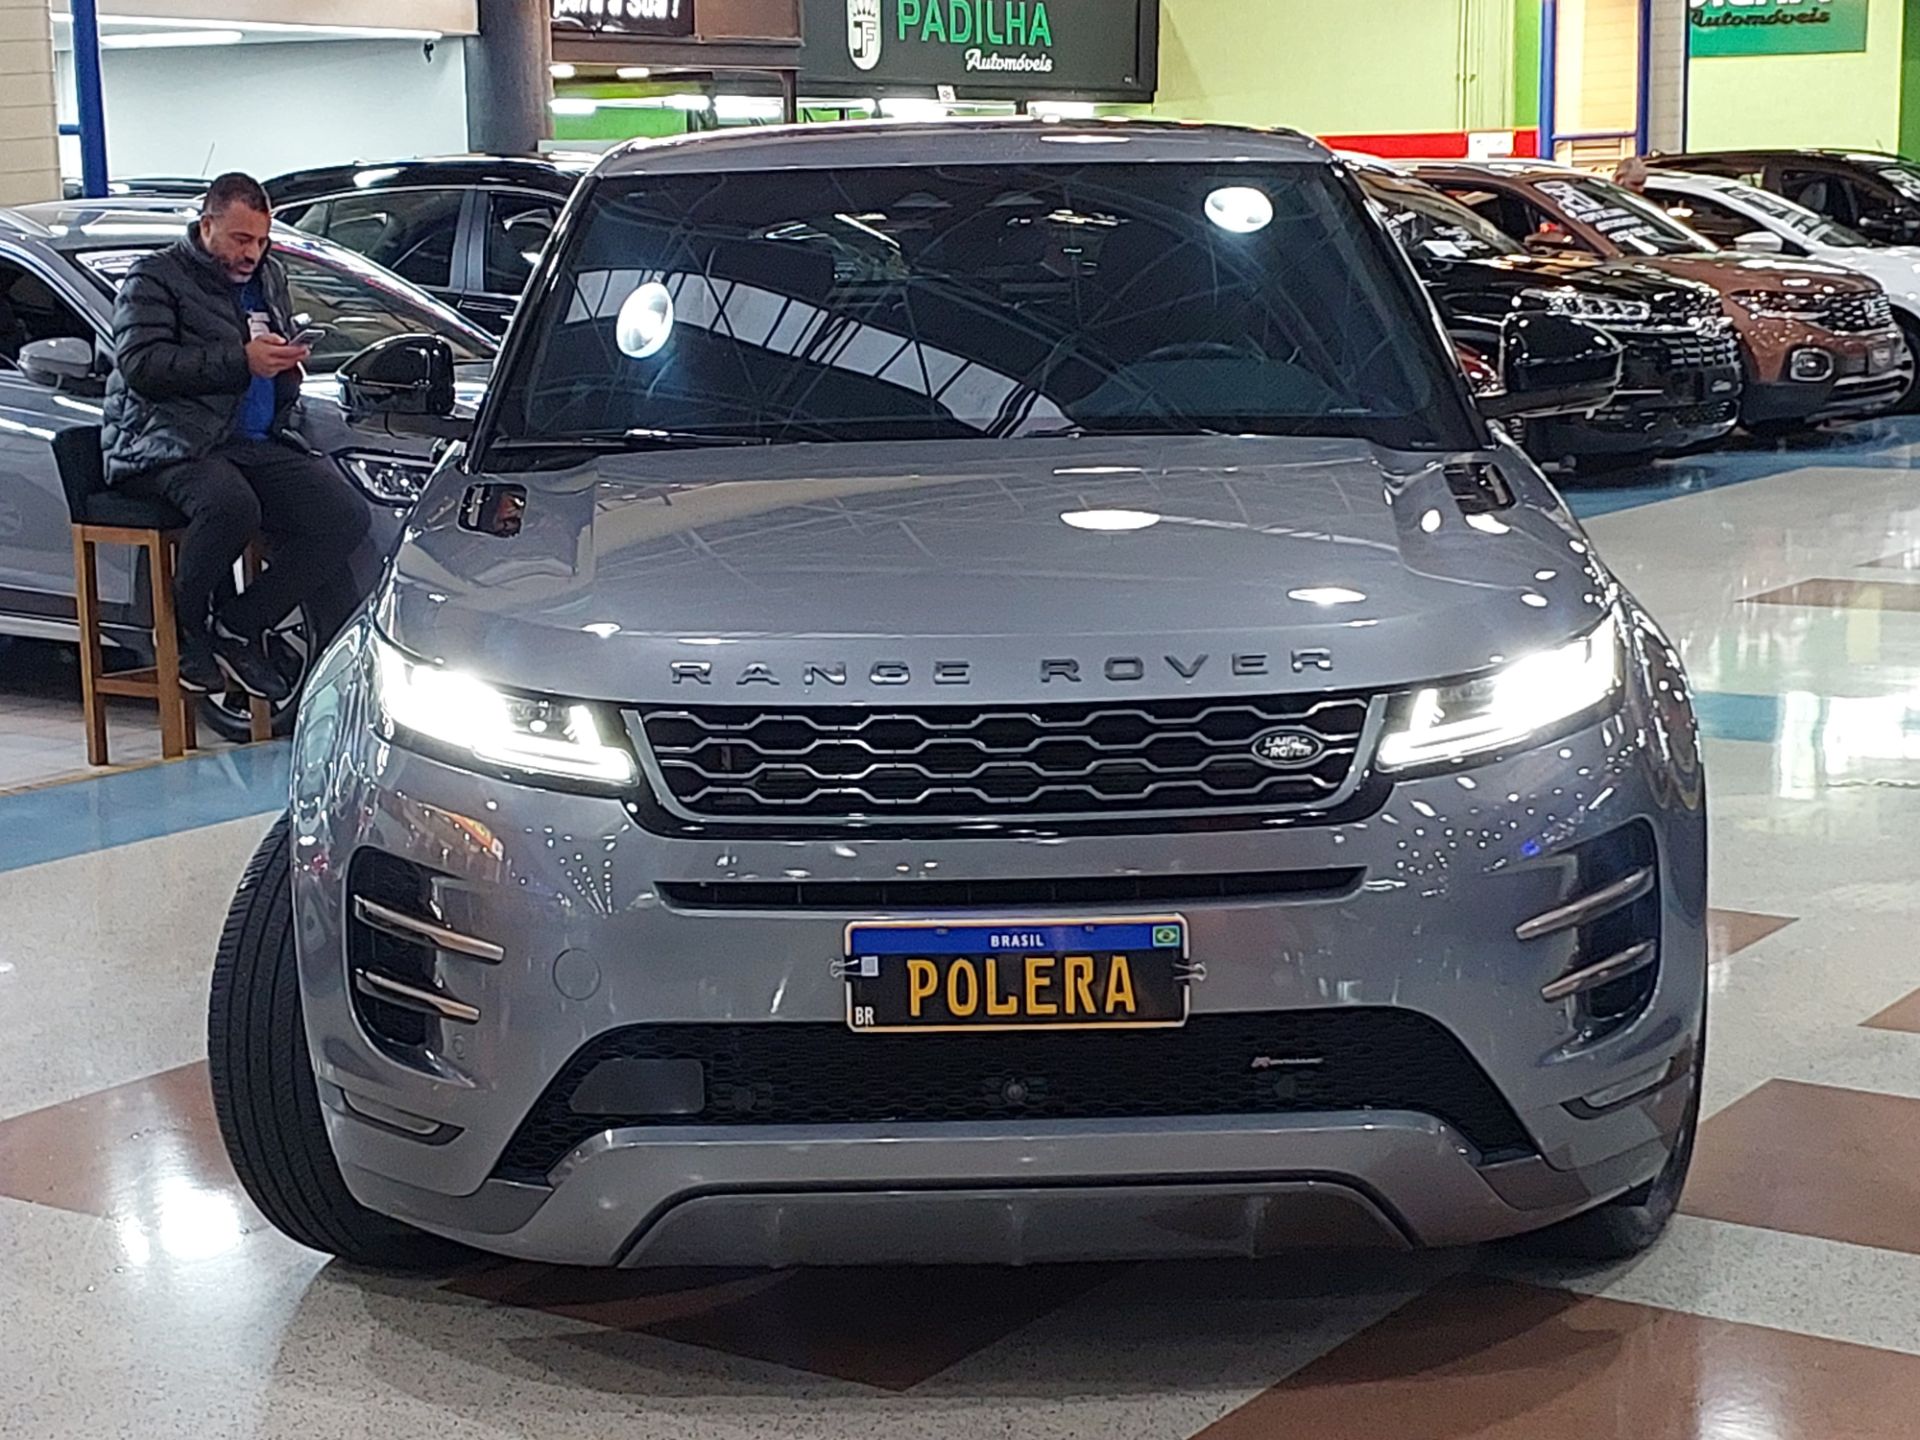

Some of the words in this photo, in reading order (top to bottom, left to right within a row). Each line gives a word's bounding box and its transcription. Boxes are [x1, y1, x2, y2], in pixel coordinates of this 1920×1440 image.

[897, 0, 1052, 46] PADILHA
[965, 48, 1053, 72] Automóveis
[670, 661, 970, 685] RANGE
[1041, 648, 1333, 683] ROVER
[990, 934, 1045, 948] BRASIL
[906, 955, 1137, 1017] POLERA
[854, 1006, 875, 1026] BR
